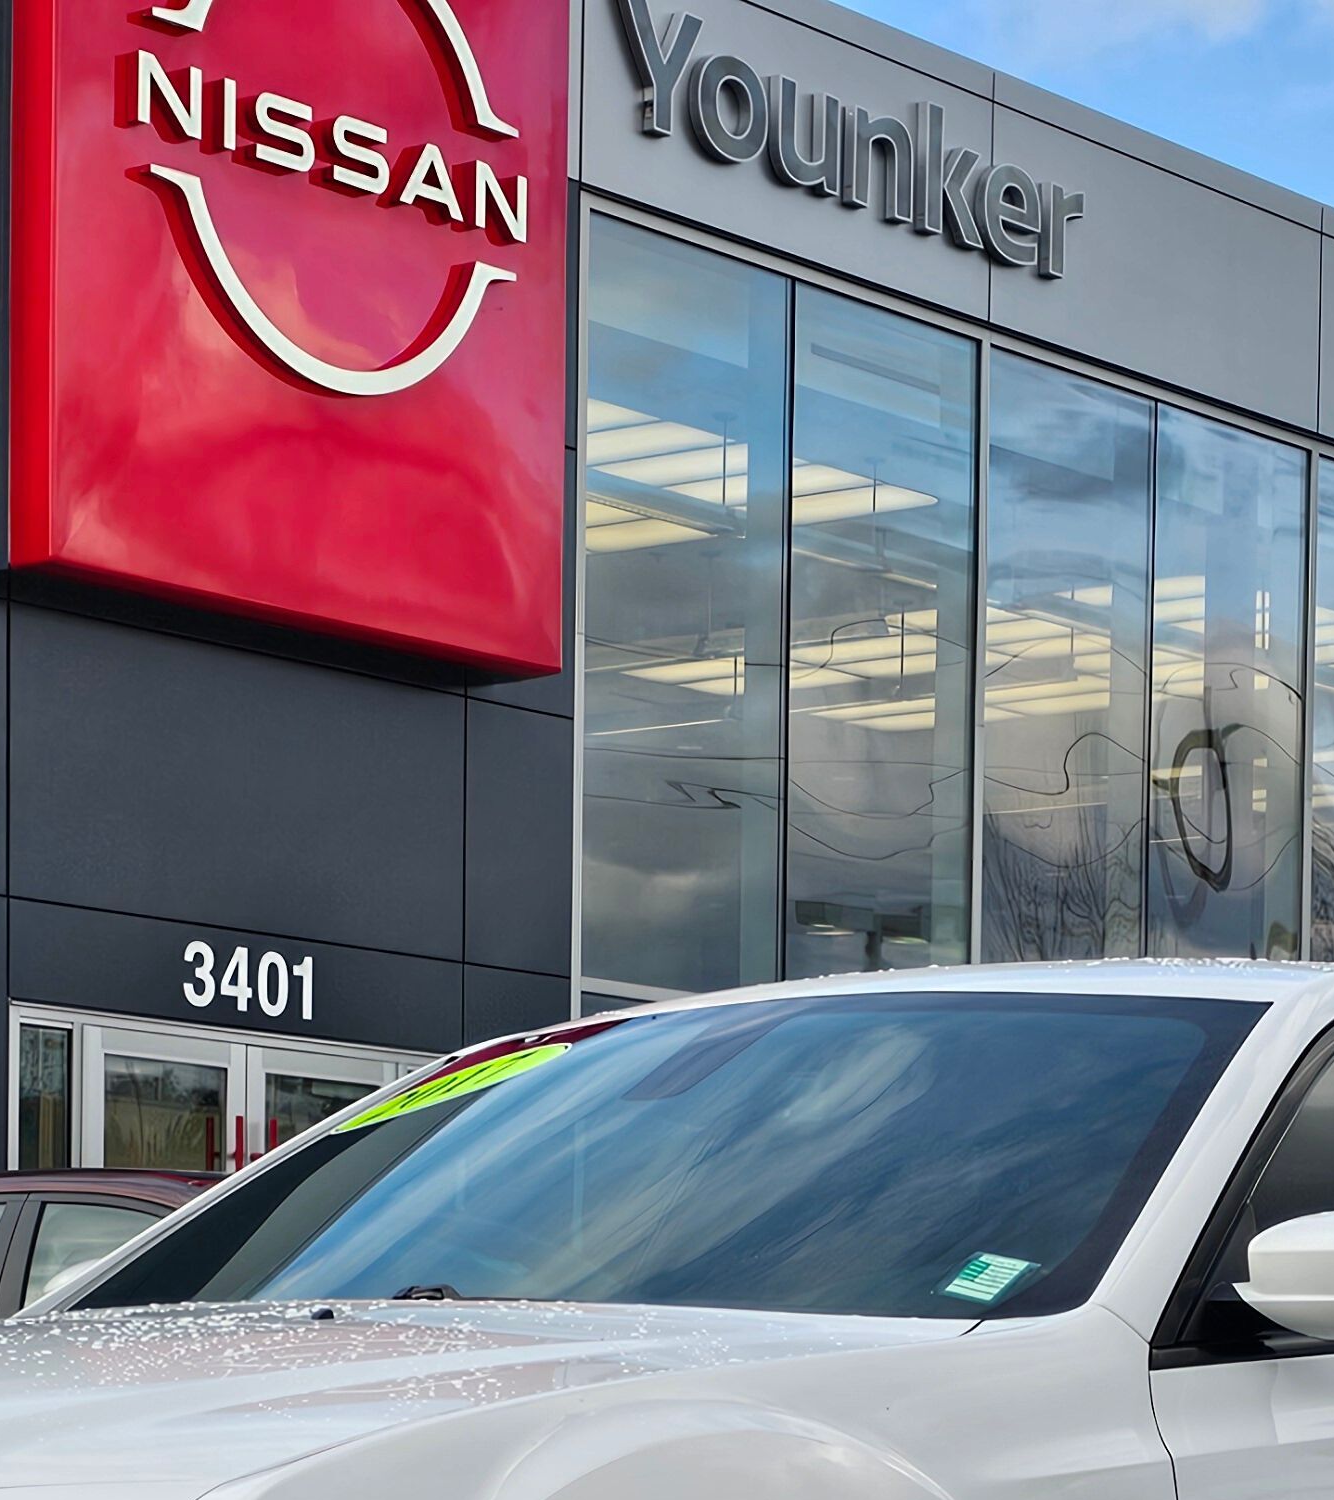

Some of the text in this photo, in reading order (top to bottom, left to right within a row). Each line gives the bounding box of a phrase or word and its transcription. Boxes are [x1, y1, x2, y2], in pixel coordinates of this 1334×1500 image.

[135, 50, 528, 243] NISSAN
[615, 0, 1085, 280] Younker
[183, 940, 313, 1020] 3401
